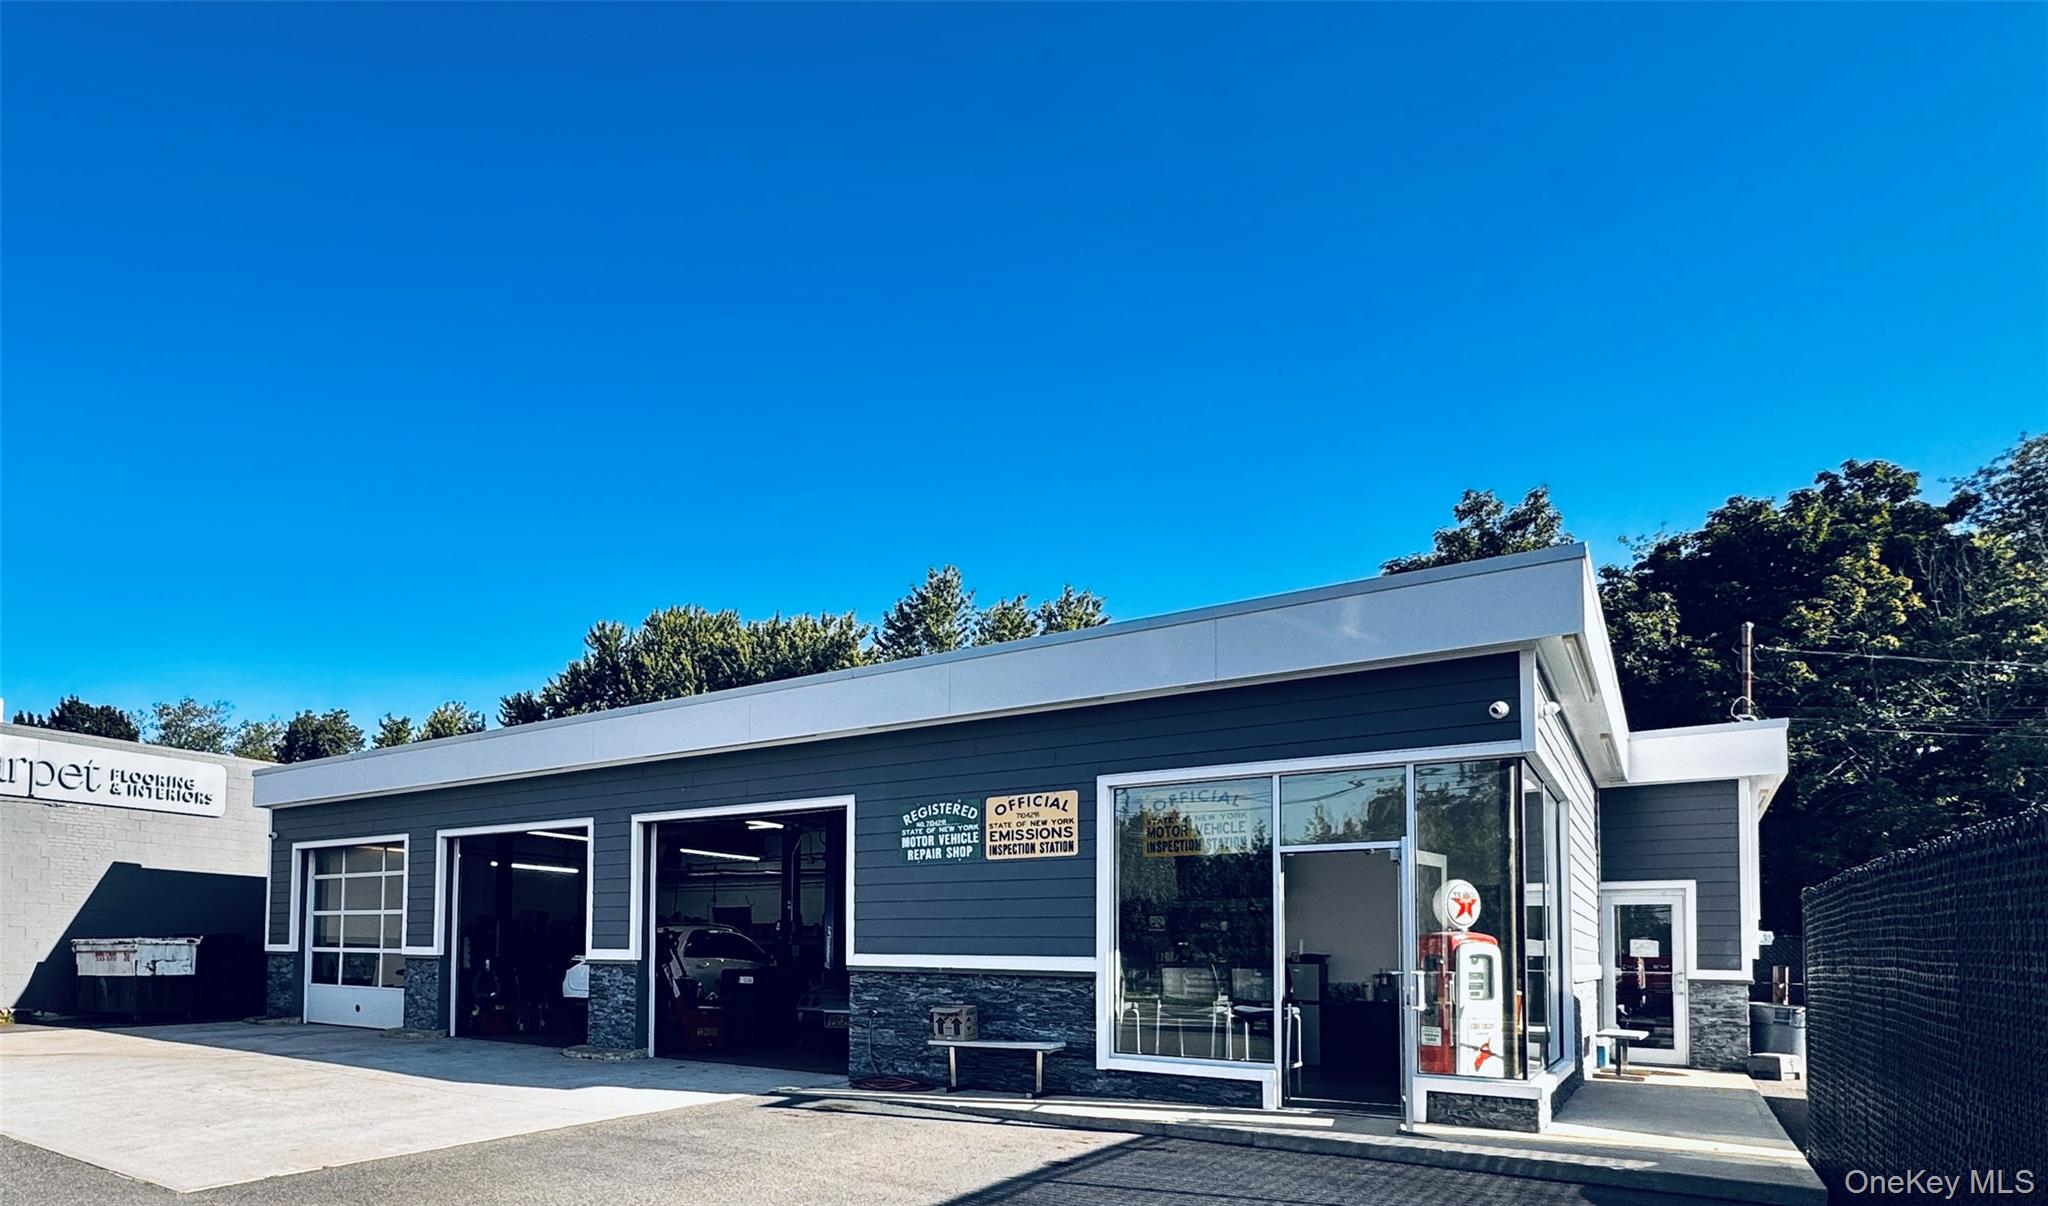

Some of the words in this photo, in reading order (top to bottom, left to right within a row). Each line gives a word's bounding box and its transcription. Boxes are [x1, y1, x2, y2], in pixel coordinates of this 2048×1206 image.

[0, 757, 101, 797] rpet
[110, 768, 195, 791] FLOORING
[109, 784, 121, 795] &
[127, 784, 213, 805] INTERIORS
[1153, 789, 1240, 812] OFFICIAL
[902, 802, 978, 826] REGISTERED
[995, 795, 1069, 816] OFFICIAL
[989, 821, 1012, 829] STATE
[1030, 819, 1048, 827] NEW
[1051, 817, 1075, 825] YORK
[1220, 811, 1247, 820] YORK
[902, 828, 924, 836] STATE
[939, 825, 954, 833] NEW
[958, 823, 979, 832] YORK
[989, 826, 1073, 842] EMISSIONS
[1146, 825, 1188, 838] MOTOR
[1195, 821, 1246, 836] VEHICLE
[901, 835, 934, 848] MOTOR
[938, 832, 979, 845] VEHICLE
[989, 843, 1036, 856] INSPECTION
[1040, 840, 1074, 854] STATION
[1146, 837, 1200, 853] INSPECTION
[1207, 835, 1248, 851] STATION
[907, 848, 941, 861] REPAIR
[946, 845, 973, 859] SHOP
